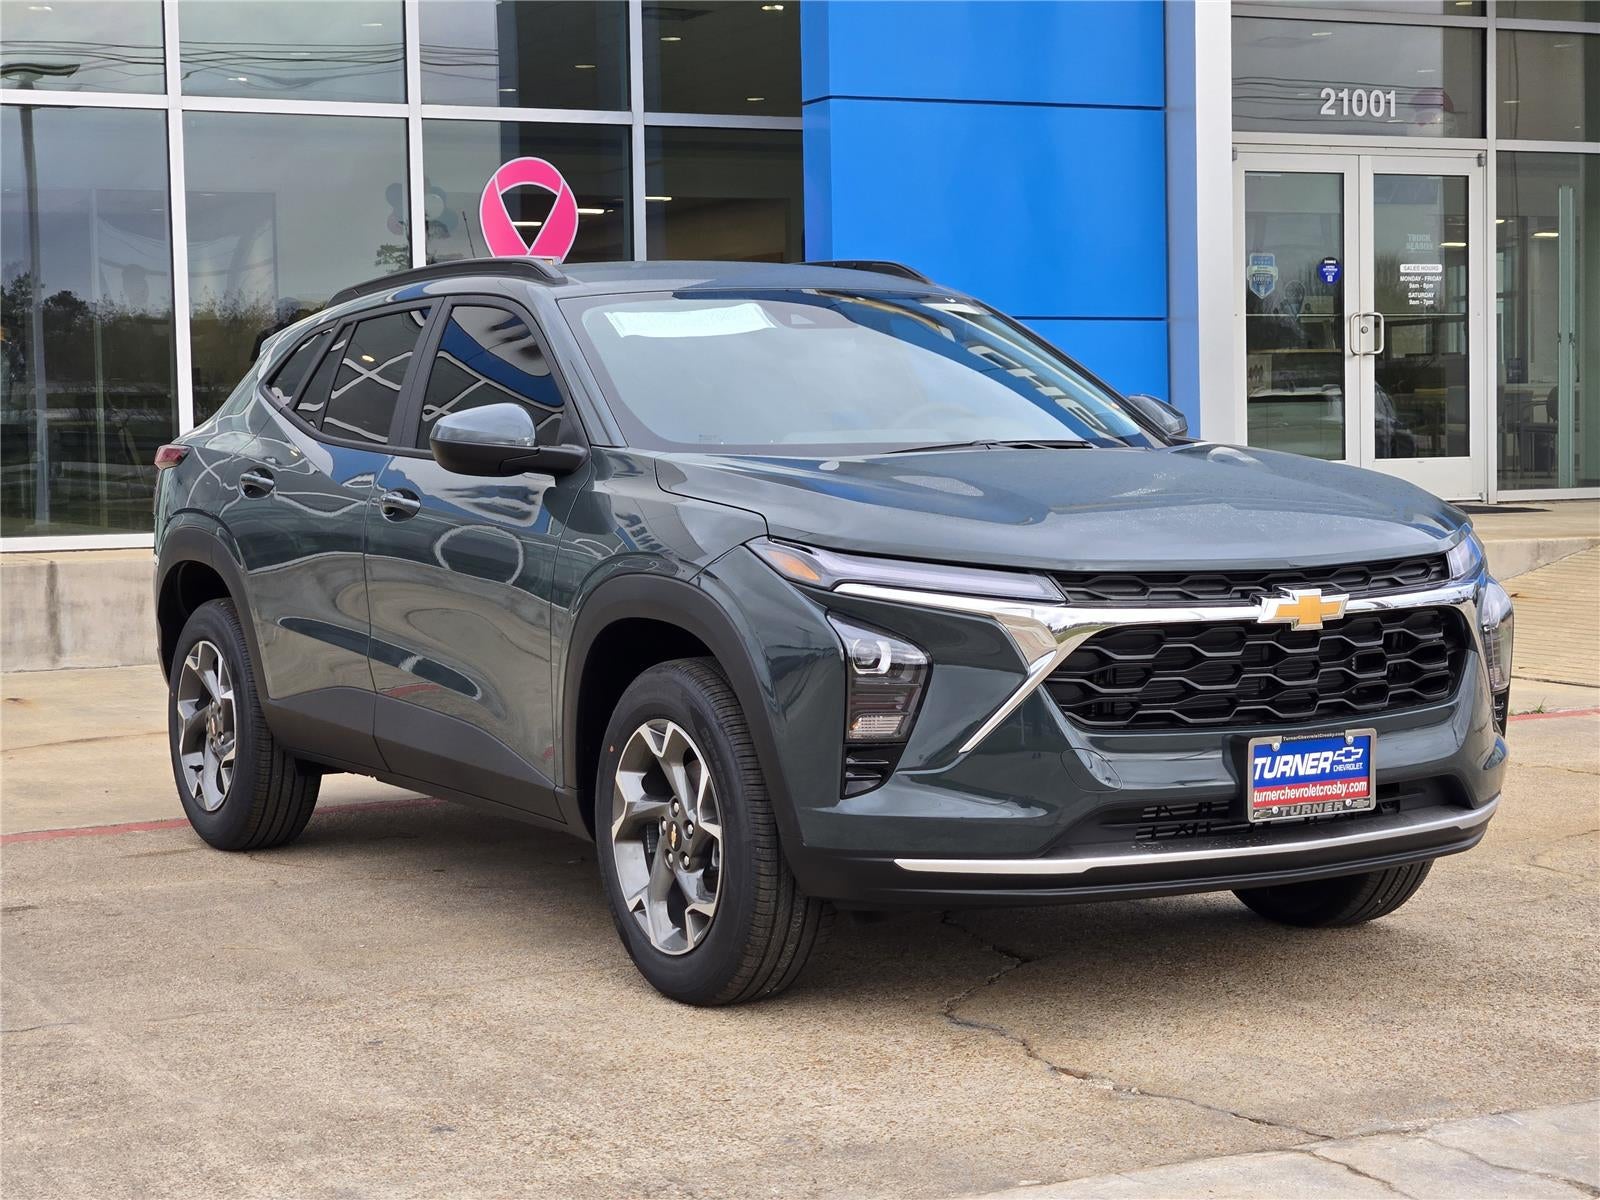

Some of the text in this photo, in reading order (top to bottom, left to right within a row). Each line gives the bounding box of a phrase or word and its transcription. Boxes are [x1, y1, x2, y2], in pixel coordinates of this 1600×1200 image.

[1320, 87, 1396, 118] 21001
[1253, 751, 1334, 780] TURNER
[1333, 762, 1363, 772] CHEVROLET
[1254, 781, 1368, 803] turnerchevroletcrosby.com
[1280, 801, 1344, 816] TURNER
